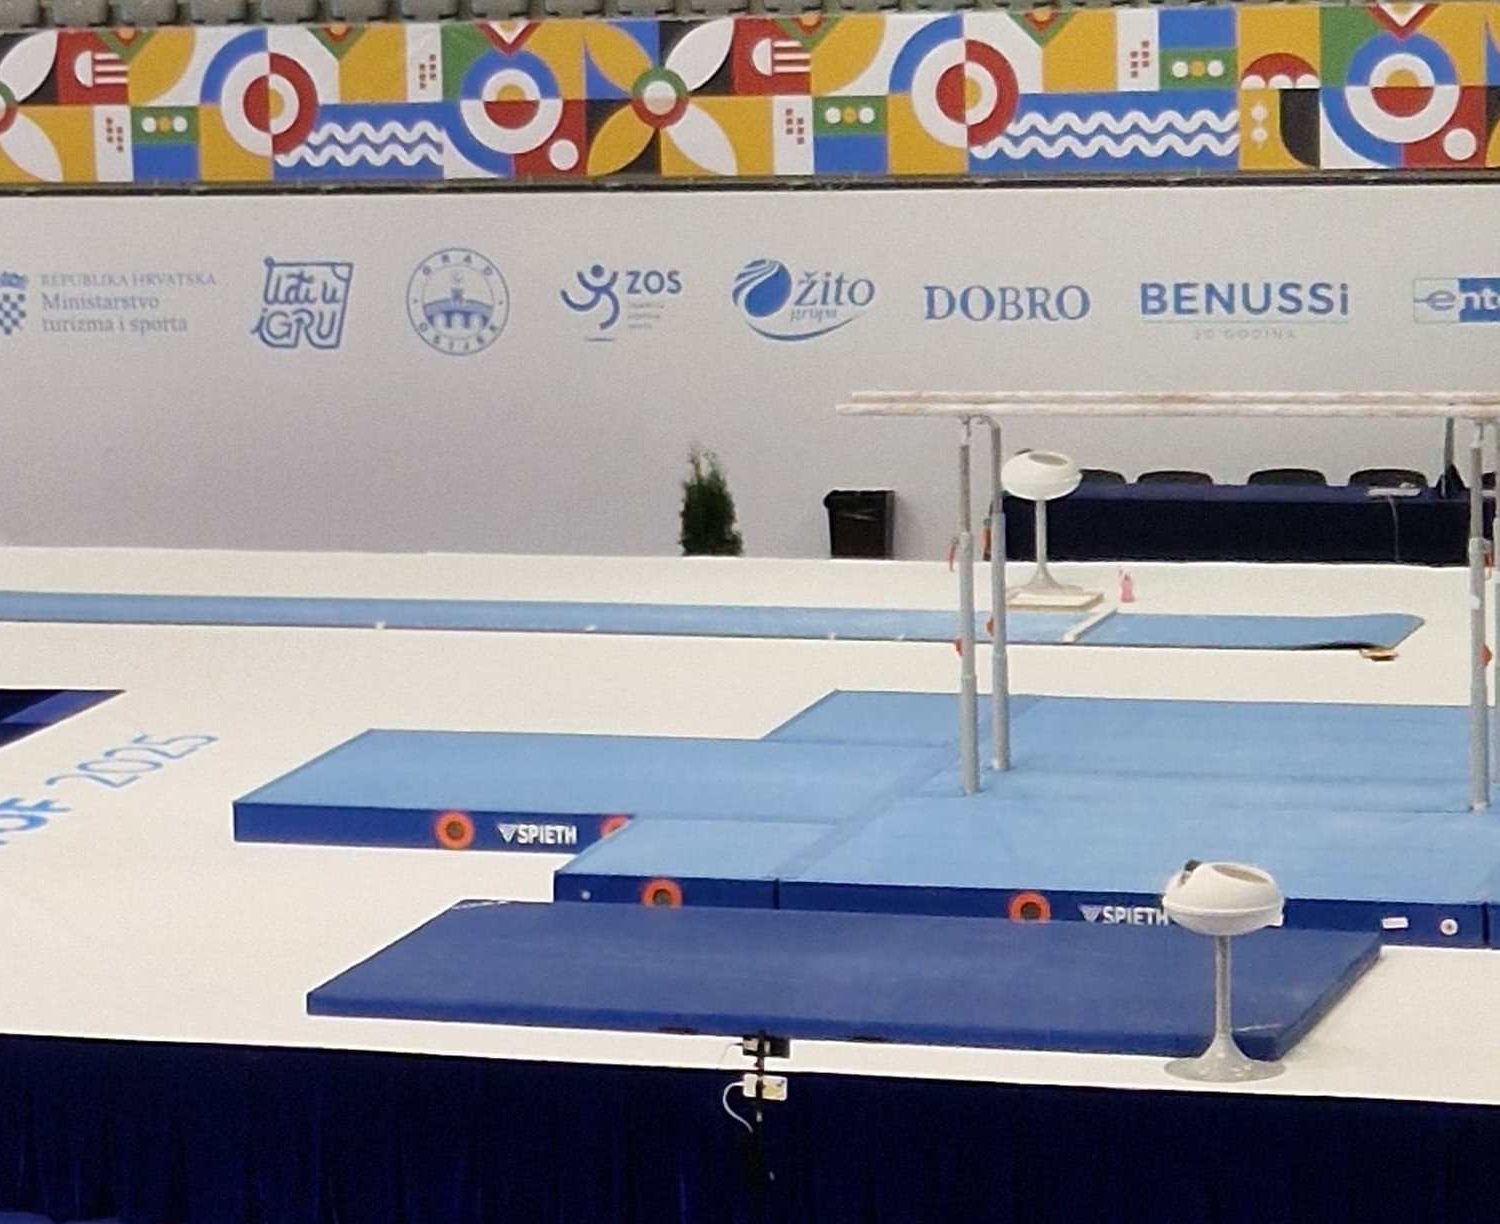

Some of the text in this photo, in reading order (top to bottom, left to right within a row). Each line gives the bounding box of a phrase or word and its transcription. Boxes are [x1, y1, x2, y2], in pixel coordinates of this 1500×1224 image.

[422, 253, 493, 276] GRAD
[40, 273, 217, 287] REPUBLIKA HRVATSKA
[626, 270, 683, 295] ZOS
[794, 271, 875, 306] žito
[41, 293, 160, 310] Ministarstvo
[924, 285, 1091, 321] DOBRO
[42, 317, 114, 332] turizma
[130, 317, 188, 335] sporta
[45, 734, 218, 788] 2025
[517, 824, 578, 845] SPIETH
[1102, 905, 1169, 926] SPIETH
